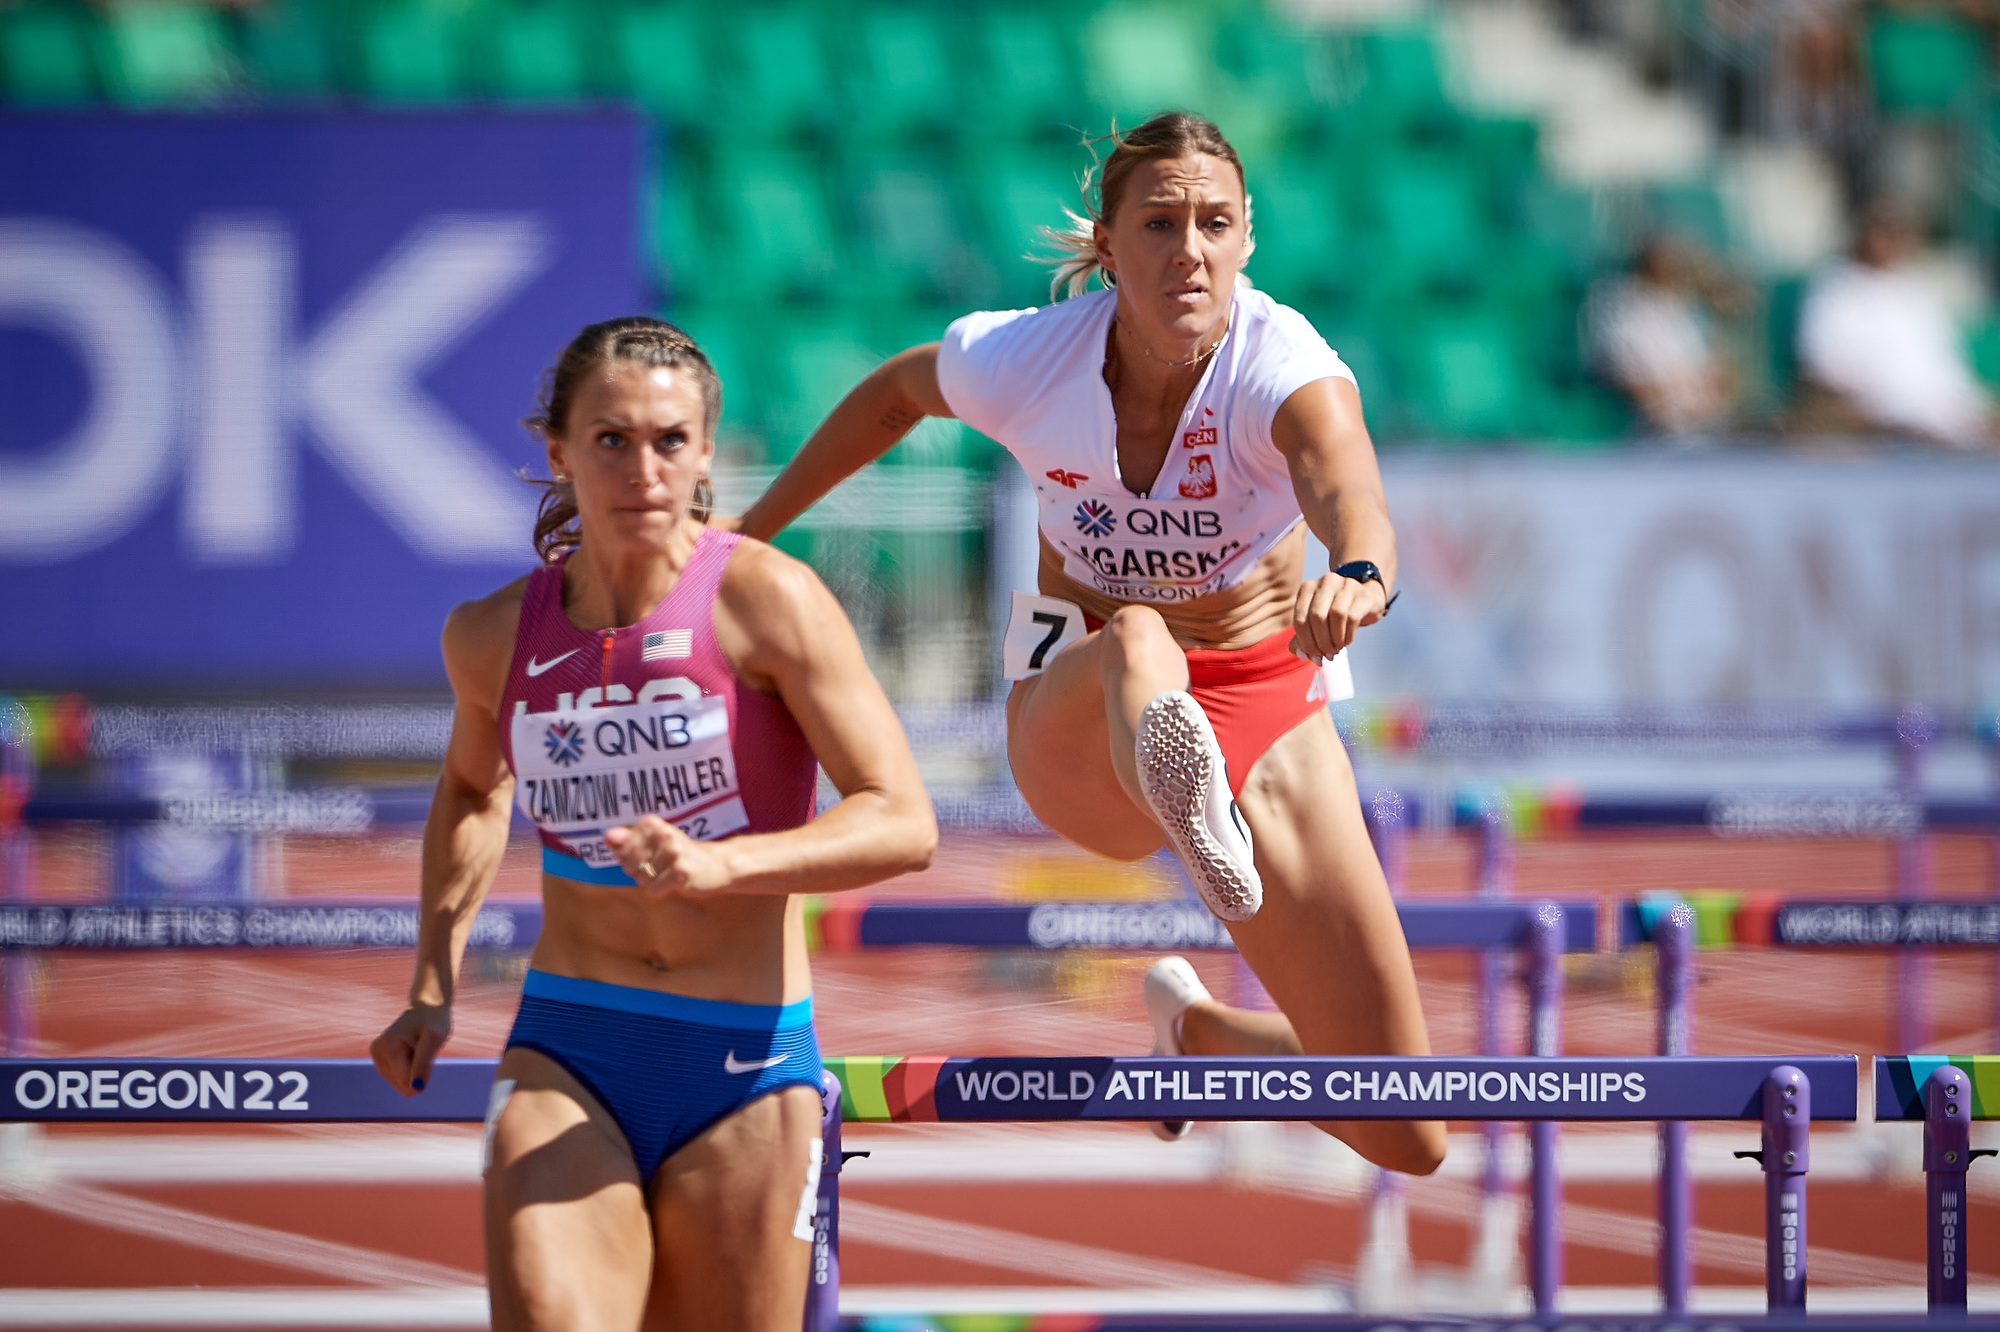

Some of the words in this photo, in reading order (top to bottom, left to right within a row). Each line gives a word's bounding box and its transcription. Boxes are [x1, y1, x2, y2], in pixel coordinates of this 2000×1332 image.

[1126, 508, 1222, 538] QNB
[1029, 611, 1067, 670] 7
[594, 714, 690, 757] QNB
[526, 756, 728, 823] ZAMZOW-MAHLER
[16, 1070, 309, 1110] OREGON22
[956, 1071, 1095, 1101] WORLD
[1105, 1070, 1312, 1101] ATHLETICS
[1325, 1070, 1647, 1102] CHAMPIONSHIPS
[814, 1216, 831, 1284] MONDO
[1780, 1212, 1798, 1281] MONDO
[1941, 1211, 1958, 1279] MONDO
